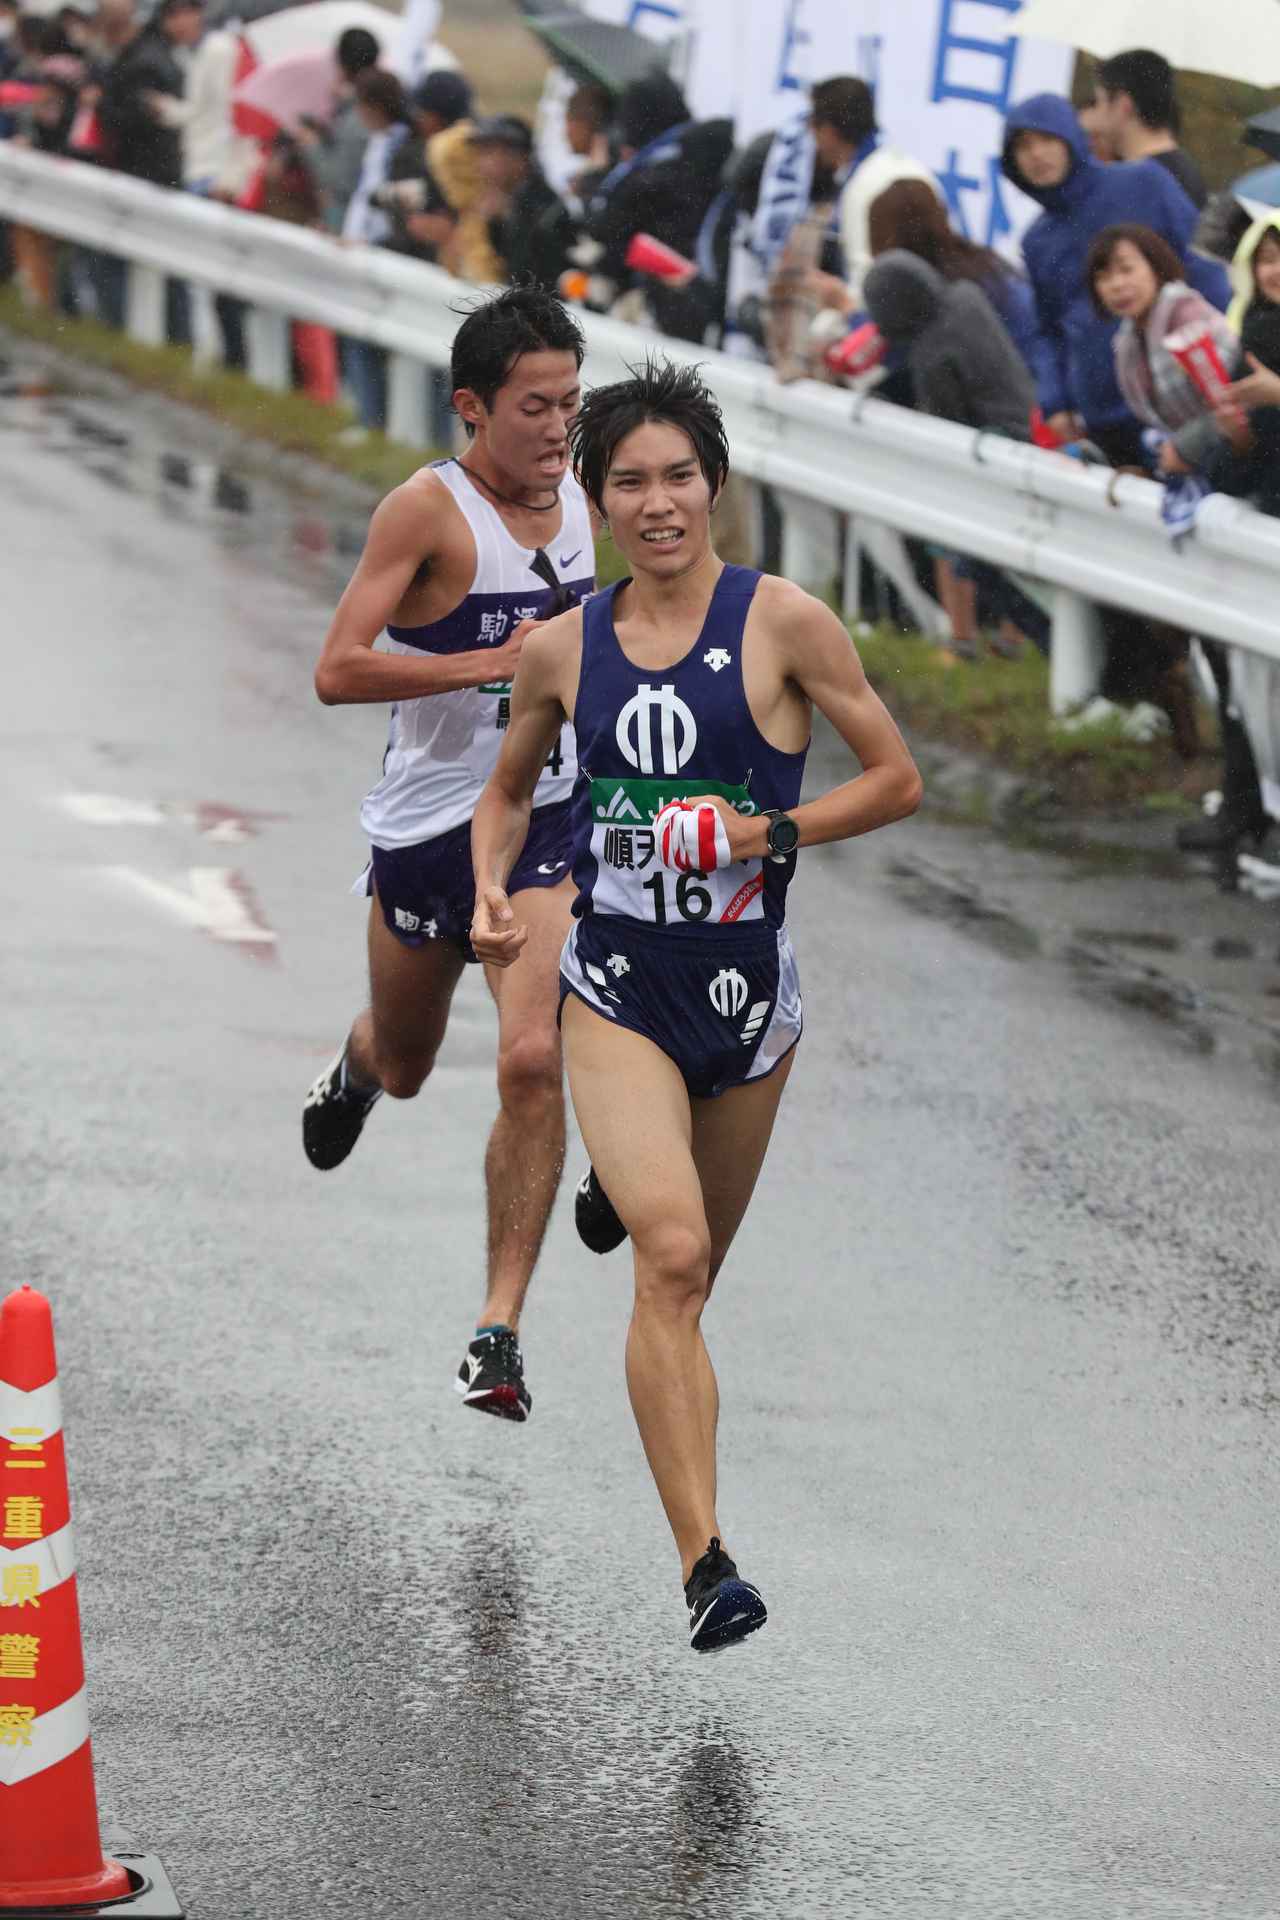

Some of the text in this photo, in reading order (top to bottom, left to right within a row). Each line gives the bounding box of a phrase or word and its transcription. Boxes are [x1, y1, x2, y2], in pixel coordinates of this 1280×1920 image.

[643, 870, 713, 923] 16
[0, 1427, 46, 1746] 三重県警察
